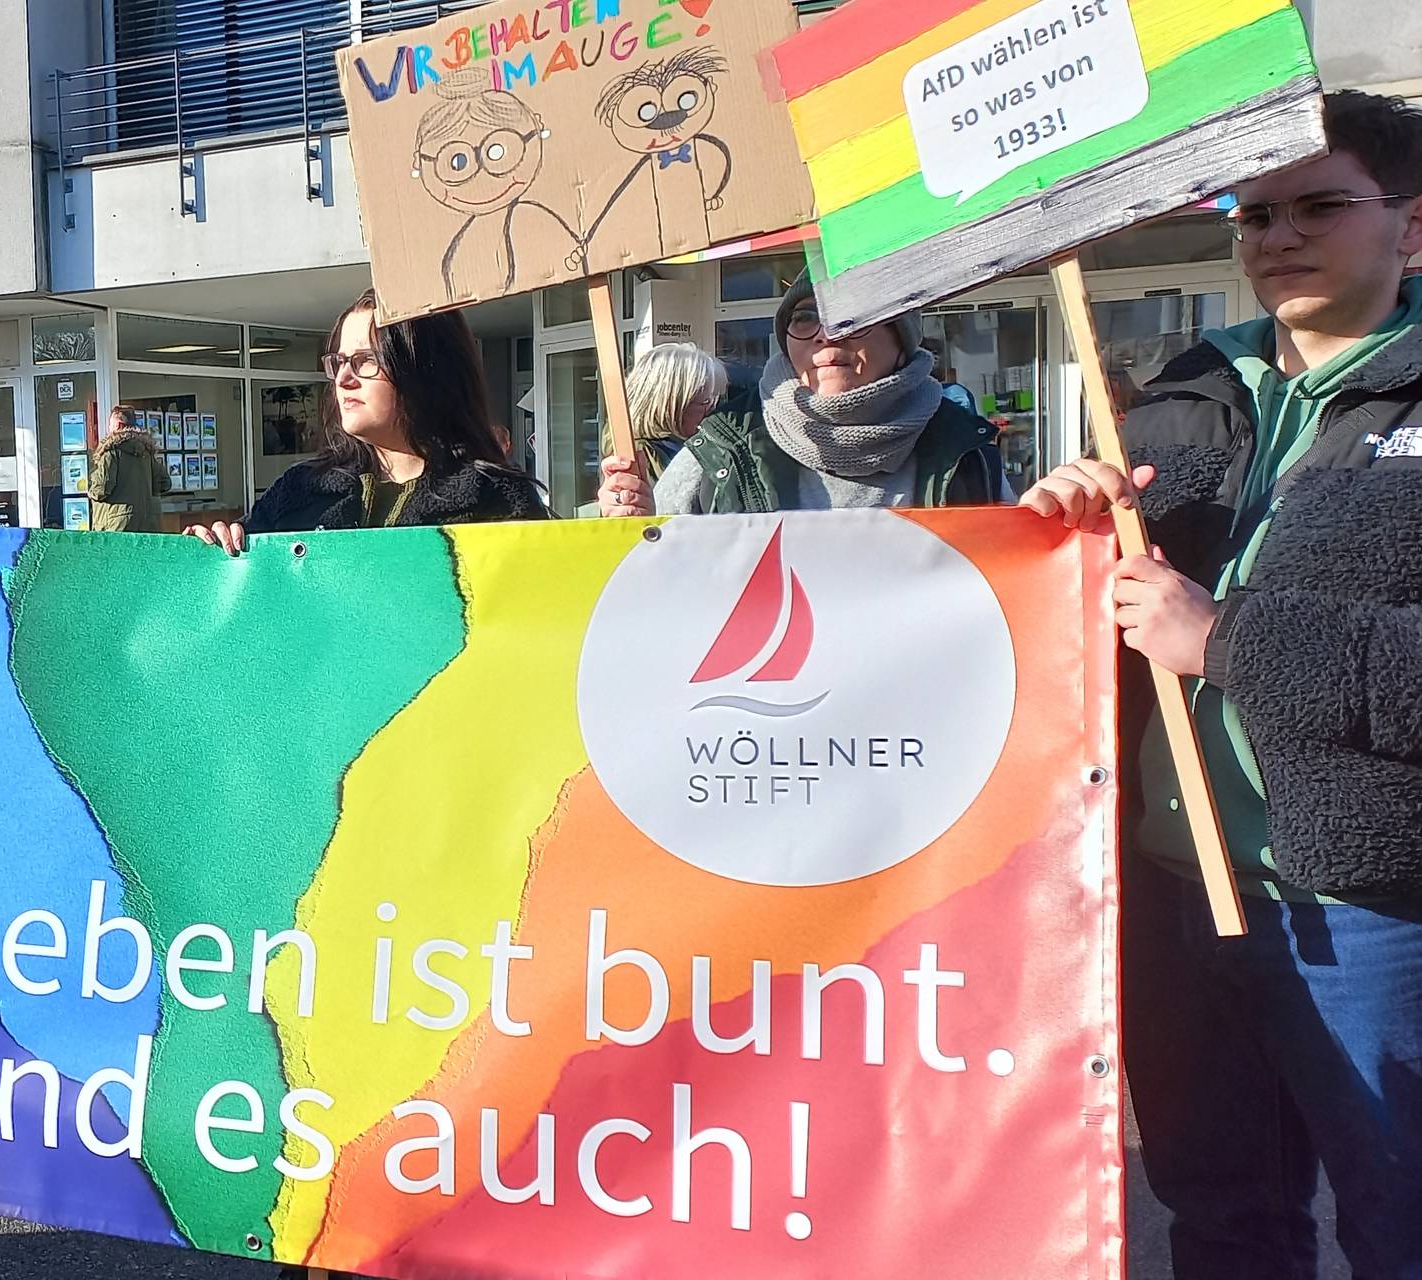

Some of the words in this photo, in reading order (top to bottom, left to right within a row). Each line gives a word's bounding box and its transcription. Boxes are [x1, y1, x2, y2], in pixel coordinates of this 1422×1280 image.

[490, 51, 538, 92] IM
[922, 64, 965, 103] AfD
[970, 18, 1067, 77] wählen
[1071, 0, 1108, 28] ist
[353, 46, 440, 103] WIR
[951, 107, 979, 132] so
[985, 80, 1037, 116] was
[1042, 54, 1094, 90] von
[993, 107, 1067, 159] 1933!
[657, 321, 691, 333] jobcenter
[1363, 431, 1411, 448] NORTH
[1375, 446, 1412, 459] FACE
[1392, 427, 1418, 438] THE
[685, 730, 924, 768] WÖLLNER
[687, 774, 820, 805] STIFT
[371, 902, 533, 1040] ist
[584, 908, 1015, 1079] bunt.
[194, 1079, 336, 1183] es
[383, 1082, 814, 1242] auch!
